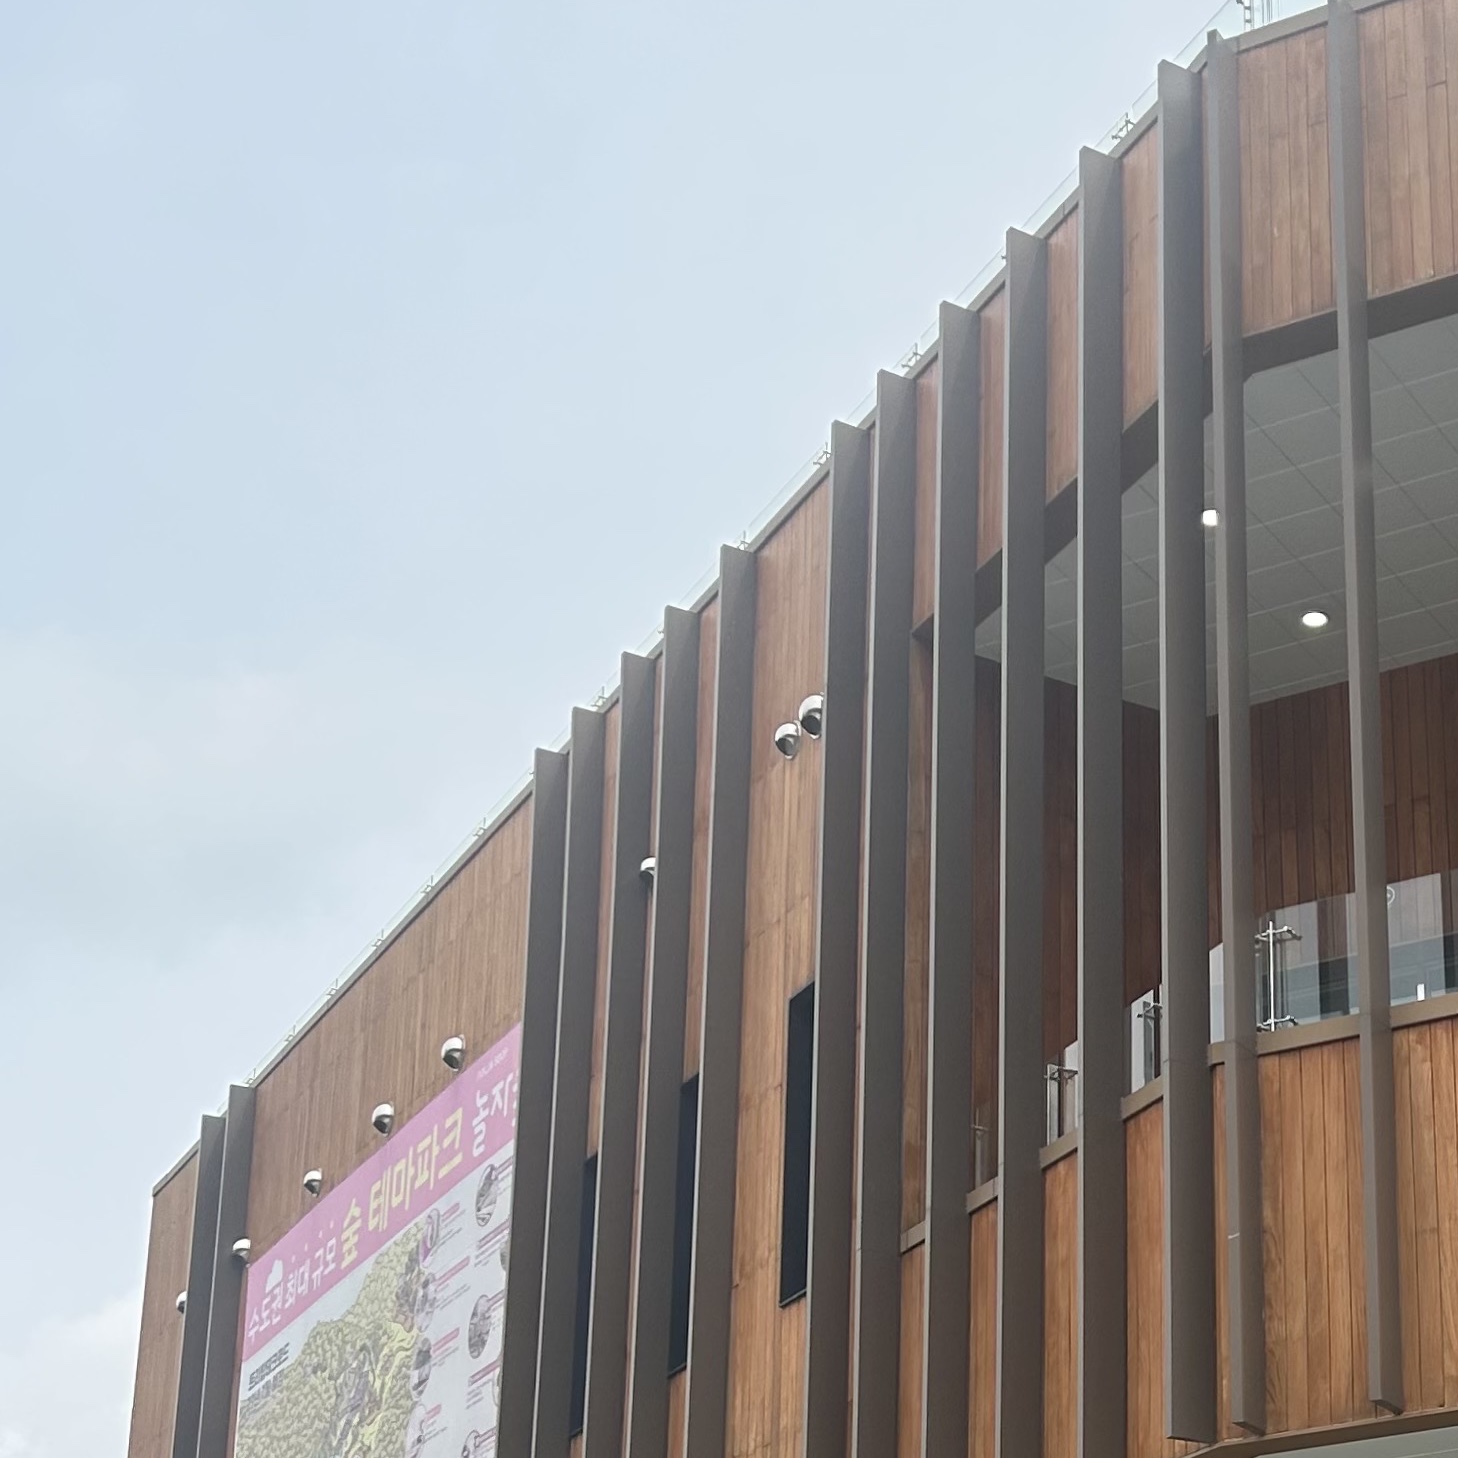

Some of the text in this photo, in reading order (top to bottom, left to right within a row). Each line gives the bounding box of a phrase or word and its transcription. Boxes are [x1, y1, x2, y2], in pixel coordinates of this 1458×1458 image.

[247, 1069, 519, 1343] 수도권 최대 규모 숲 테마파크 놀자
